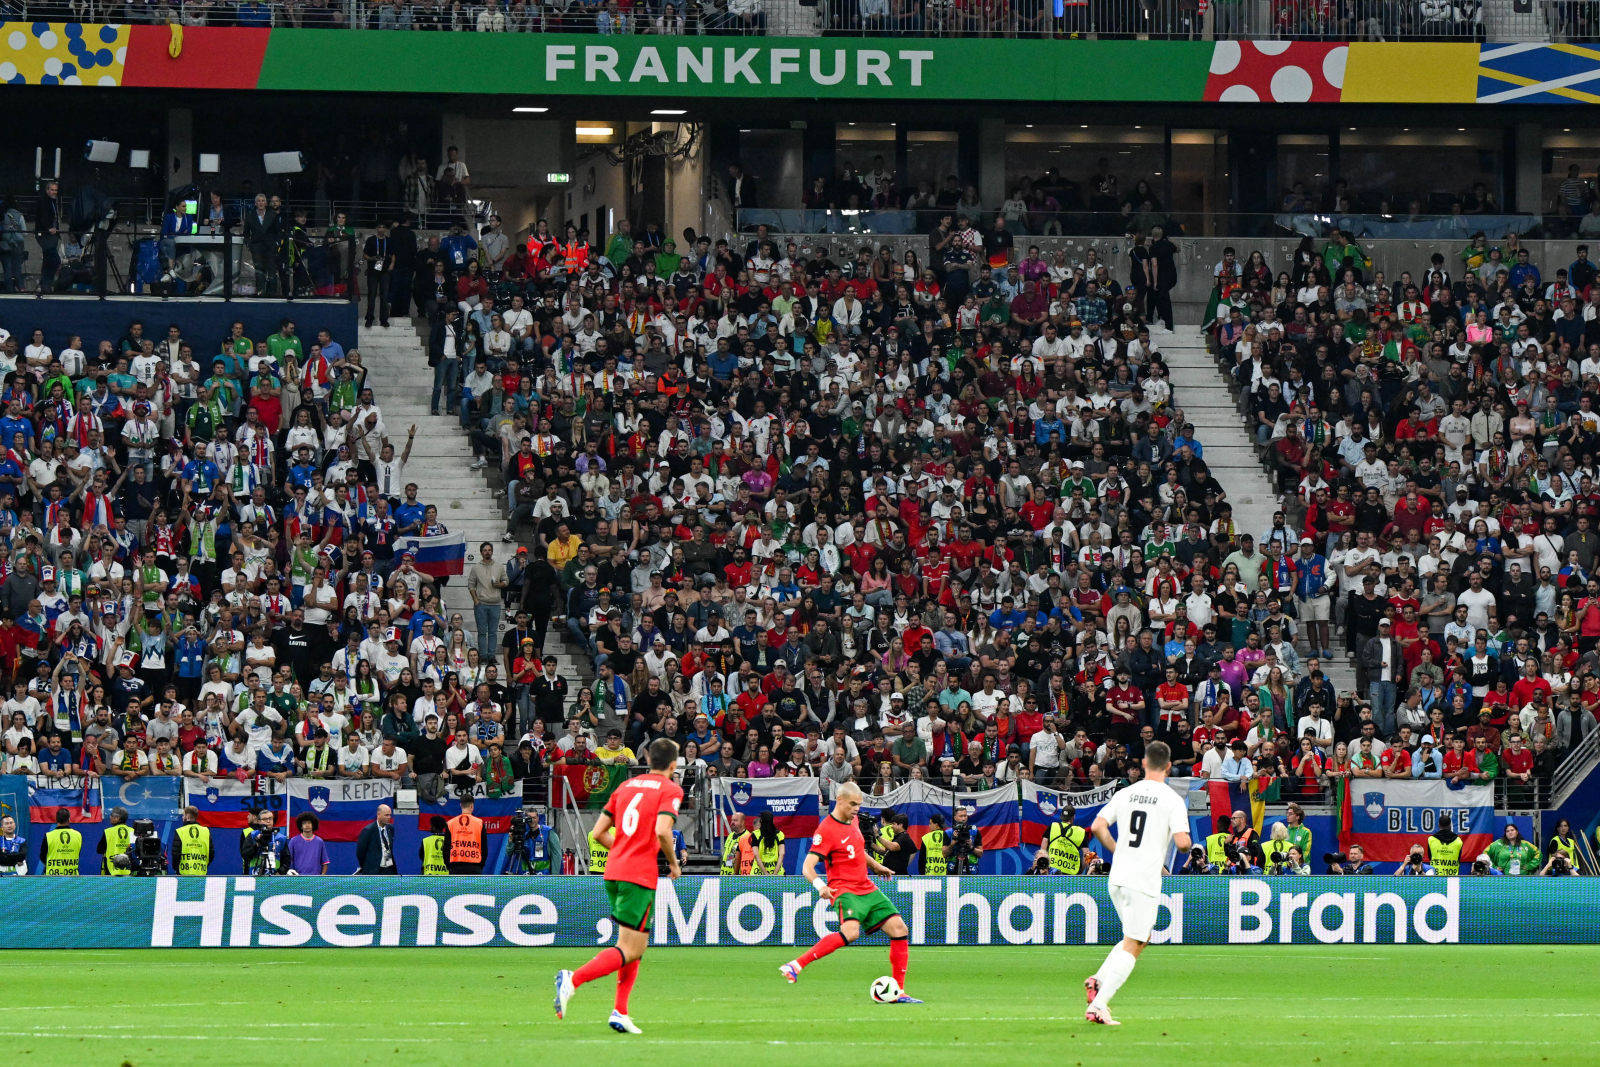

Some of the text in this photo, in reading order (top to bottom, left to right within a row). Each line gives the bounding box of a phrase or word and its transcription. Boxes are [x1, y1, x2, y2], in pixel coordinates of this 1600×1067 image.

[545, 44, 934, 87] FRANKFURT
[342, 780, 393, 801] REPEN
[1058, 787, 1115, 807] FRANKFURT
[621, 792, 644, 837] 6
[1128, 810, 1148, 848] 9
[846, 844, 856, 859] 3
[1050, 848, 1079, 861] TEWARD
[150, 877, 559, 947] Hisense
[653, 877, 839, 945] More
[897, 876, 1099, 945] Than
[1228, 876, 1460, 944] Brand
